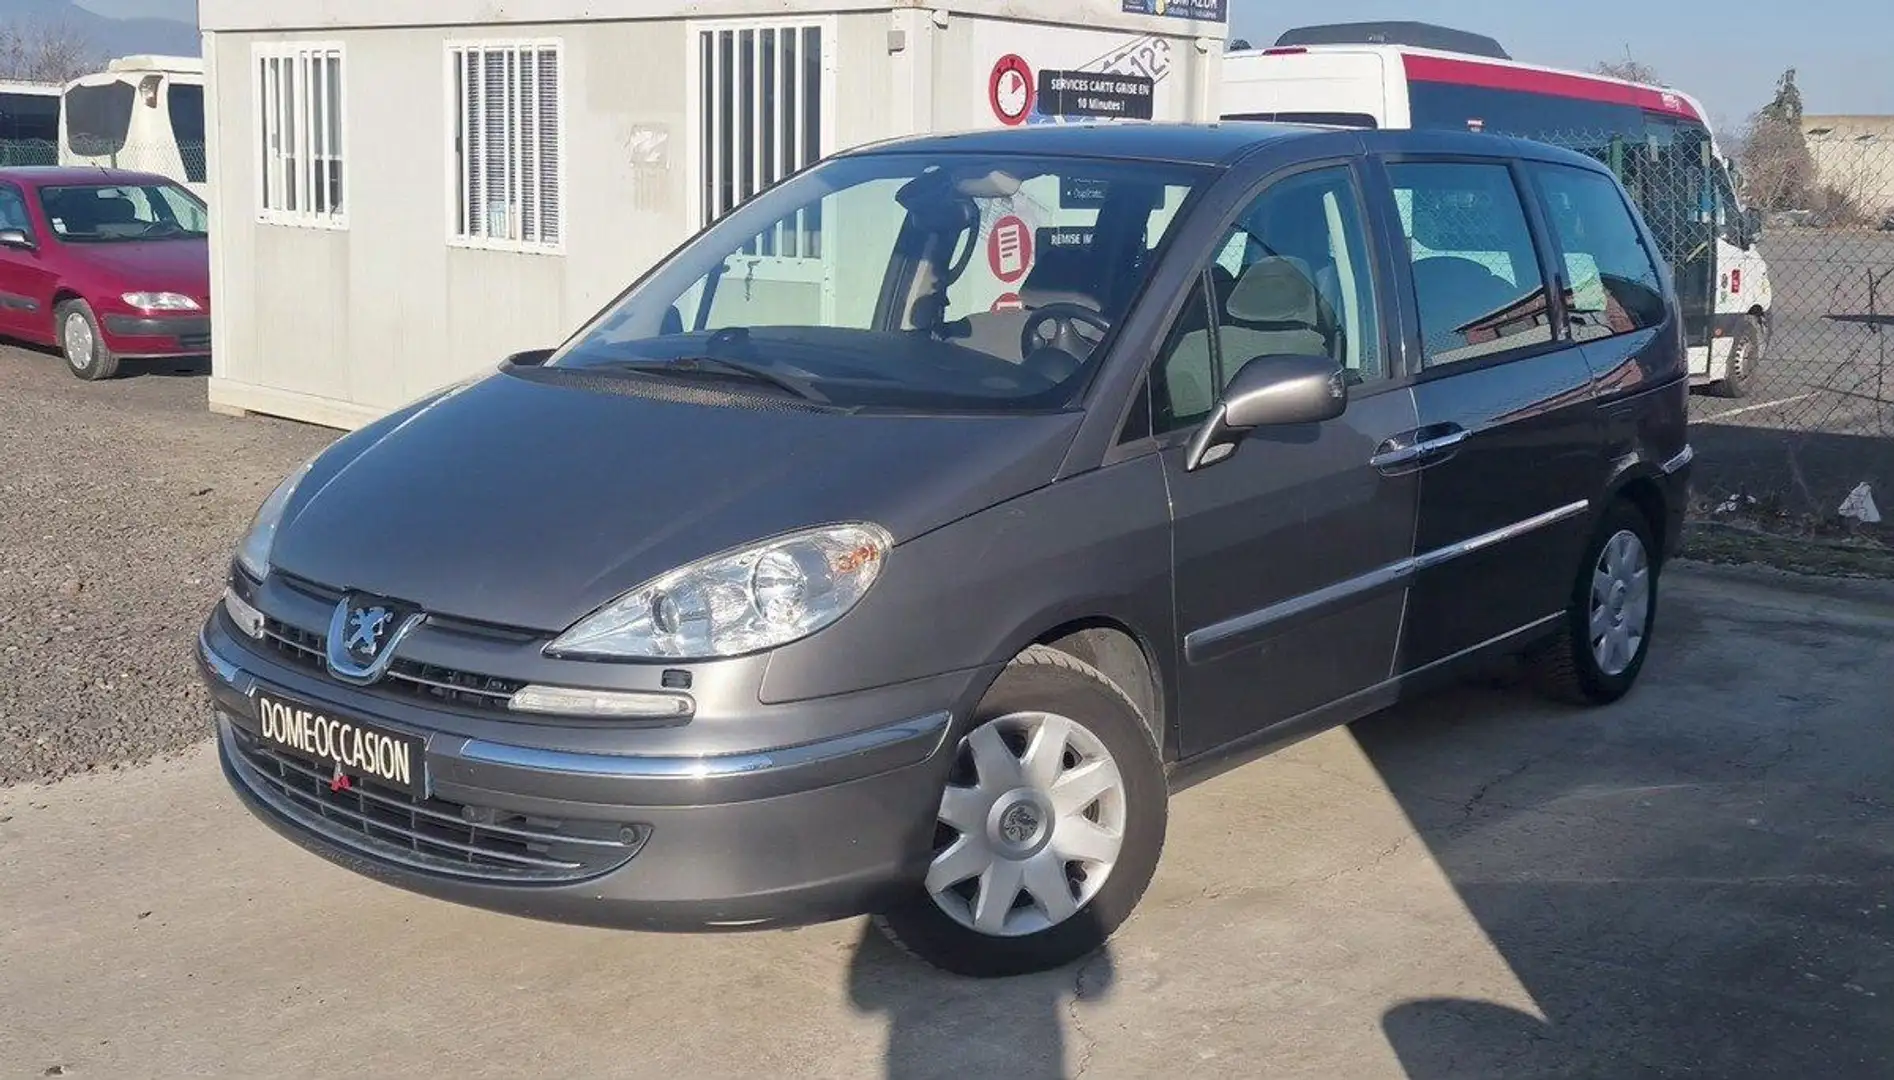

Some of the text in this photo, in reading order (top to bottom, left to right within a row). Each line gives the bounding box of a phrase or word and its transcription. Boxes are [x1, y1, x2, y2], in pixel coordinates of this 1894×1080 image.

[1051, 78, 1150, 95] SERVICES CARTE GRISE EN
[1077, 98, 1087, 109] 10
[1051, 233, 1081, 246] REMISE
[260, 698, 410, 785] DOMEOCCASION
